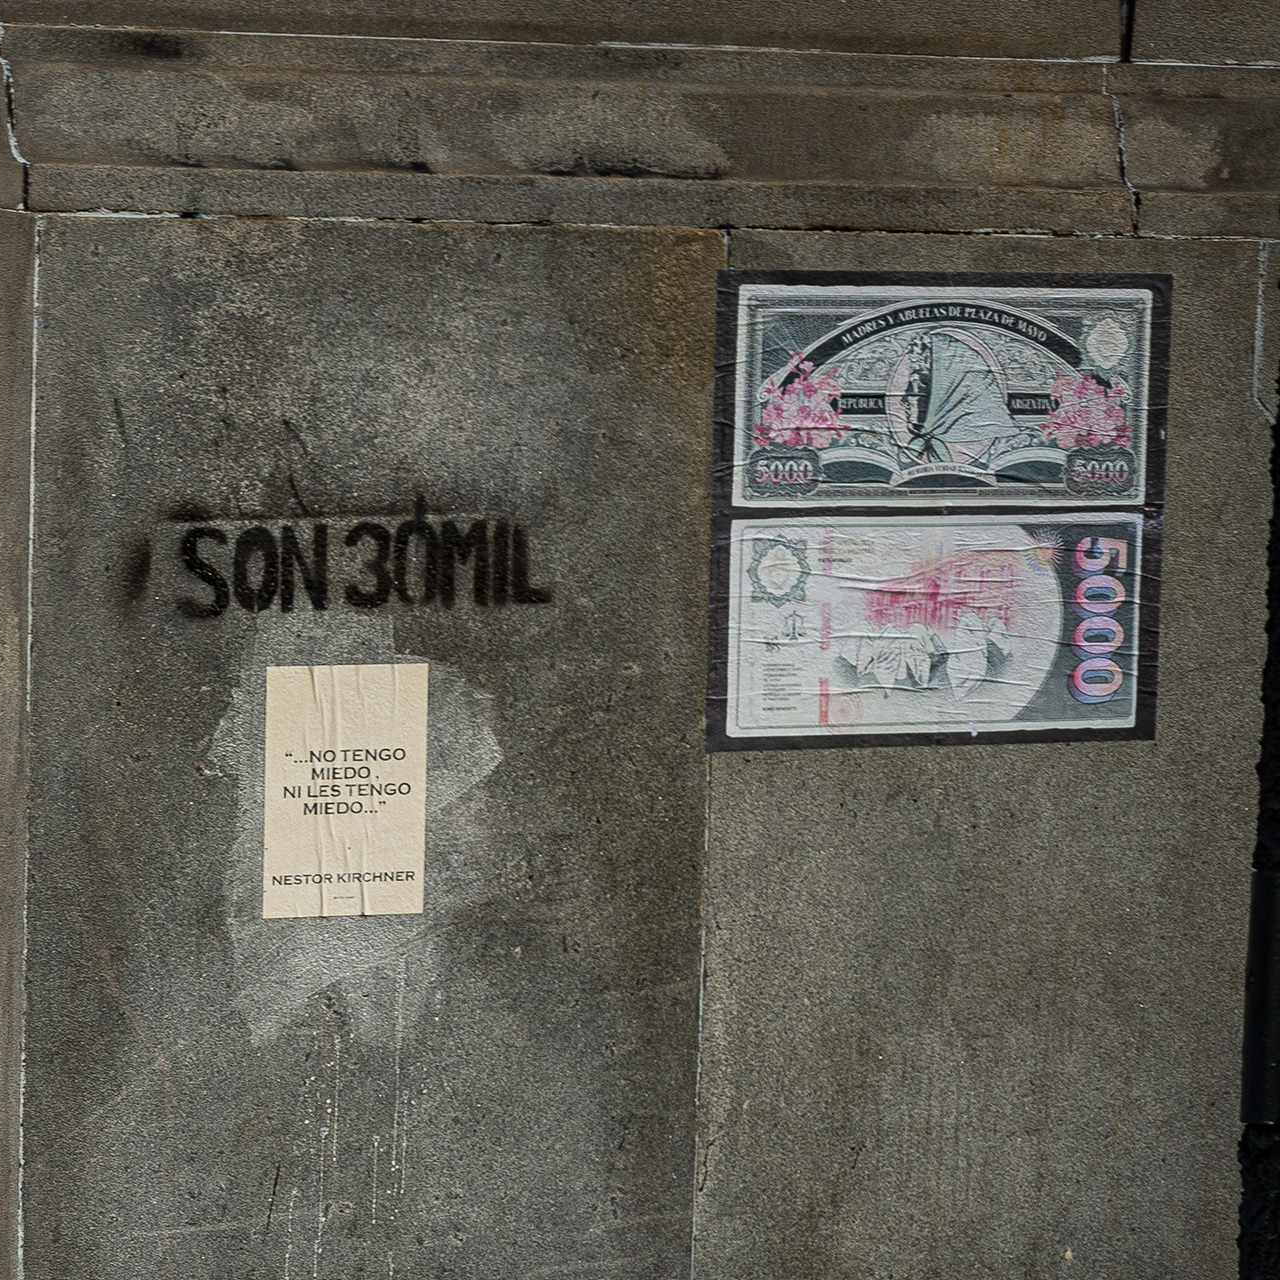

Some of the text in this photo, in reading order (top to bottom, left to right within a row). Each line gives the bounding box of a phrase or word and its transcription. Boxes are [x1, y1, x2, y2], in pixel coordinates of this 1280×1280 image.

[841, 306, 1049, 346] MADRES Y ABUELAS DE PLAZA DE MAYO
[753, 459, 814, 483] 5000
[1070, 459, 1130, 483] 5000
[1068, 536, 1129, 704] 5000
[340, 748, 407, 762] TENGO
[283, 782, 412, 799] NI LES TENGO
[272, 871, 416, 886] NESTOR KIRCHNER
